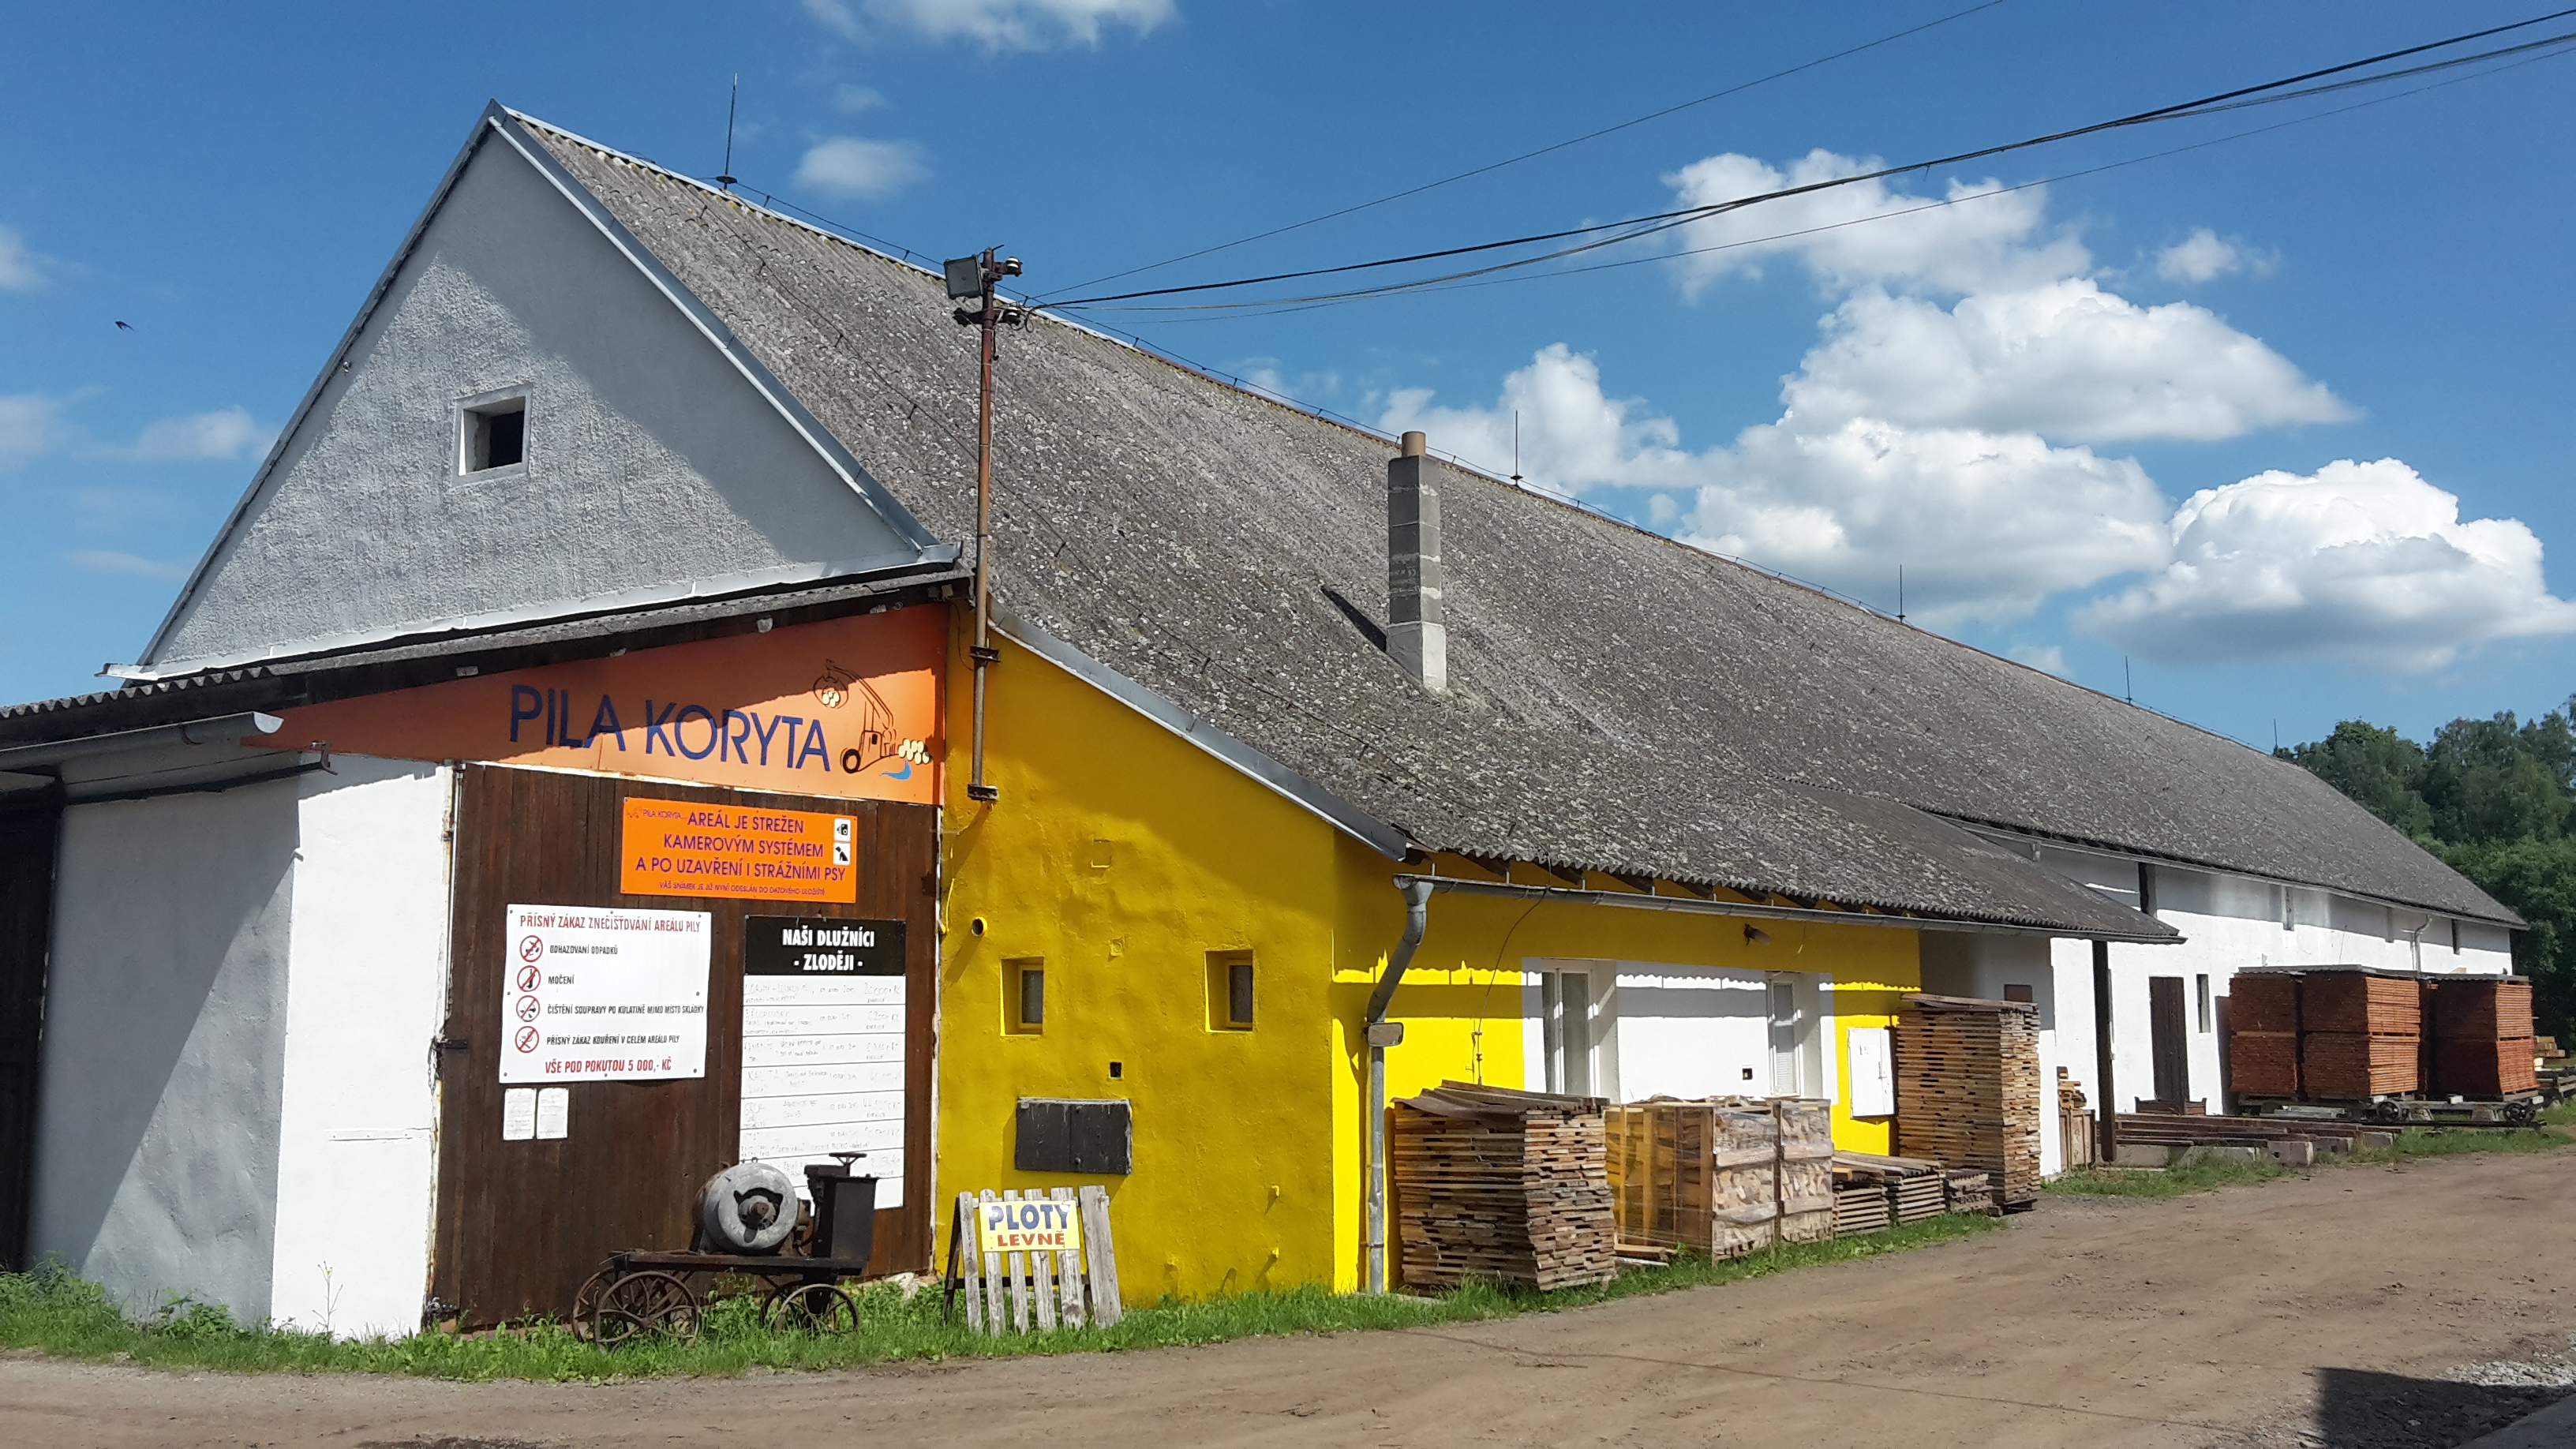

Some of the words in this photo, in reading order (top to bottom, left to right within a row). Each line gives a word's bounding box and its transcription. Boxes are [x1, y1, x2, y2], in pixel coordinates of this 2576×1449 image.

[510, 684, 626, 751] PILA
[646, 699, 830, 772] KORYTA
[687, 809, 730, 829] AREÁL
[734, 815, 748, 829] JE
[664, 833, 754, 853] KAMEROVÝM
[758, 838, 824, 858] SYSTÉMEM
[635, 856, 646, 871] A
[651, 857, 672, 873] PO
[676, 857, 743, 876] UZAVŘENÍ
[747, 863, 750, 876] I
[754, 859, 821, 880] STRÁŽNÍMI
[825, 867, 846, 882] PSY
[520, 912, 556, 927] PŘÍSNÝ
[558, 913, 586, 928] ZÁKAZ
[588, 915, 652, 930] ZNEČIŠŤOVÁNÍ
[654, 917, 683, 931] AREÁLU
[686, 920, 701, 932] PILY
[782, 925, 813, 946] NAŠI
[817, 926, 875, 947] DLUŽNÍCI
[803, 950, 855, 971] ZLODĚJI
[548, 974, 575, 984] MOČENÍ
[547, 1003, 573, 1014] ČIŠTĚNÍ
[575, 1005, 607, 1014] SOUPRAVY
[608, 1005, 616, 1014] PO
[618, 1003, 646, 1014] KULATINĚ
[647, 1005, 664, 1014] MIMO
[546, 1034, 571, 1045] PŘÍSNÝ
[572, 1035, 591, 1045] ZÁKAZ
[593, 1033, 620, 1044] KOUŘENÍ
[621, 1035, 626, 1044] V
[626, 1034, 646, 1043] CELÉM
[545, 1058, 562, 1073] VŠE
[565, 1060, 582, 1073] POD
[585, 1059, 625, 1073] POKUTOU
[661, 1056, 672, 1071] KČ
[988, 1204, 1071, 1231] PLOTY
[998, 1230, 1065, 1247] LEVNĚ
